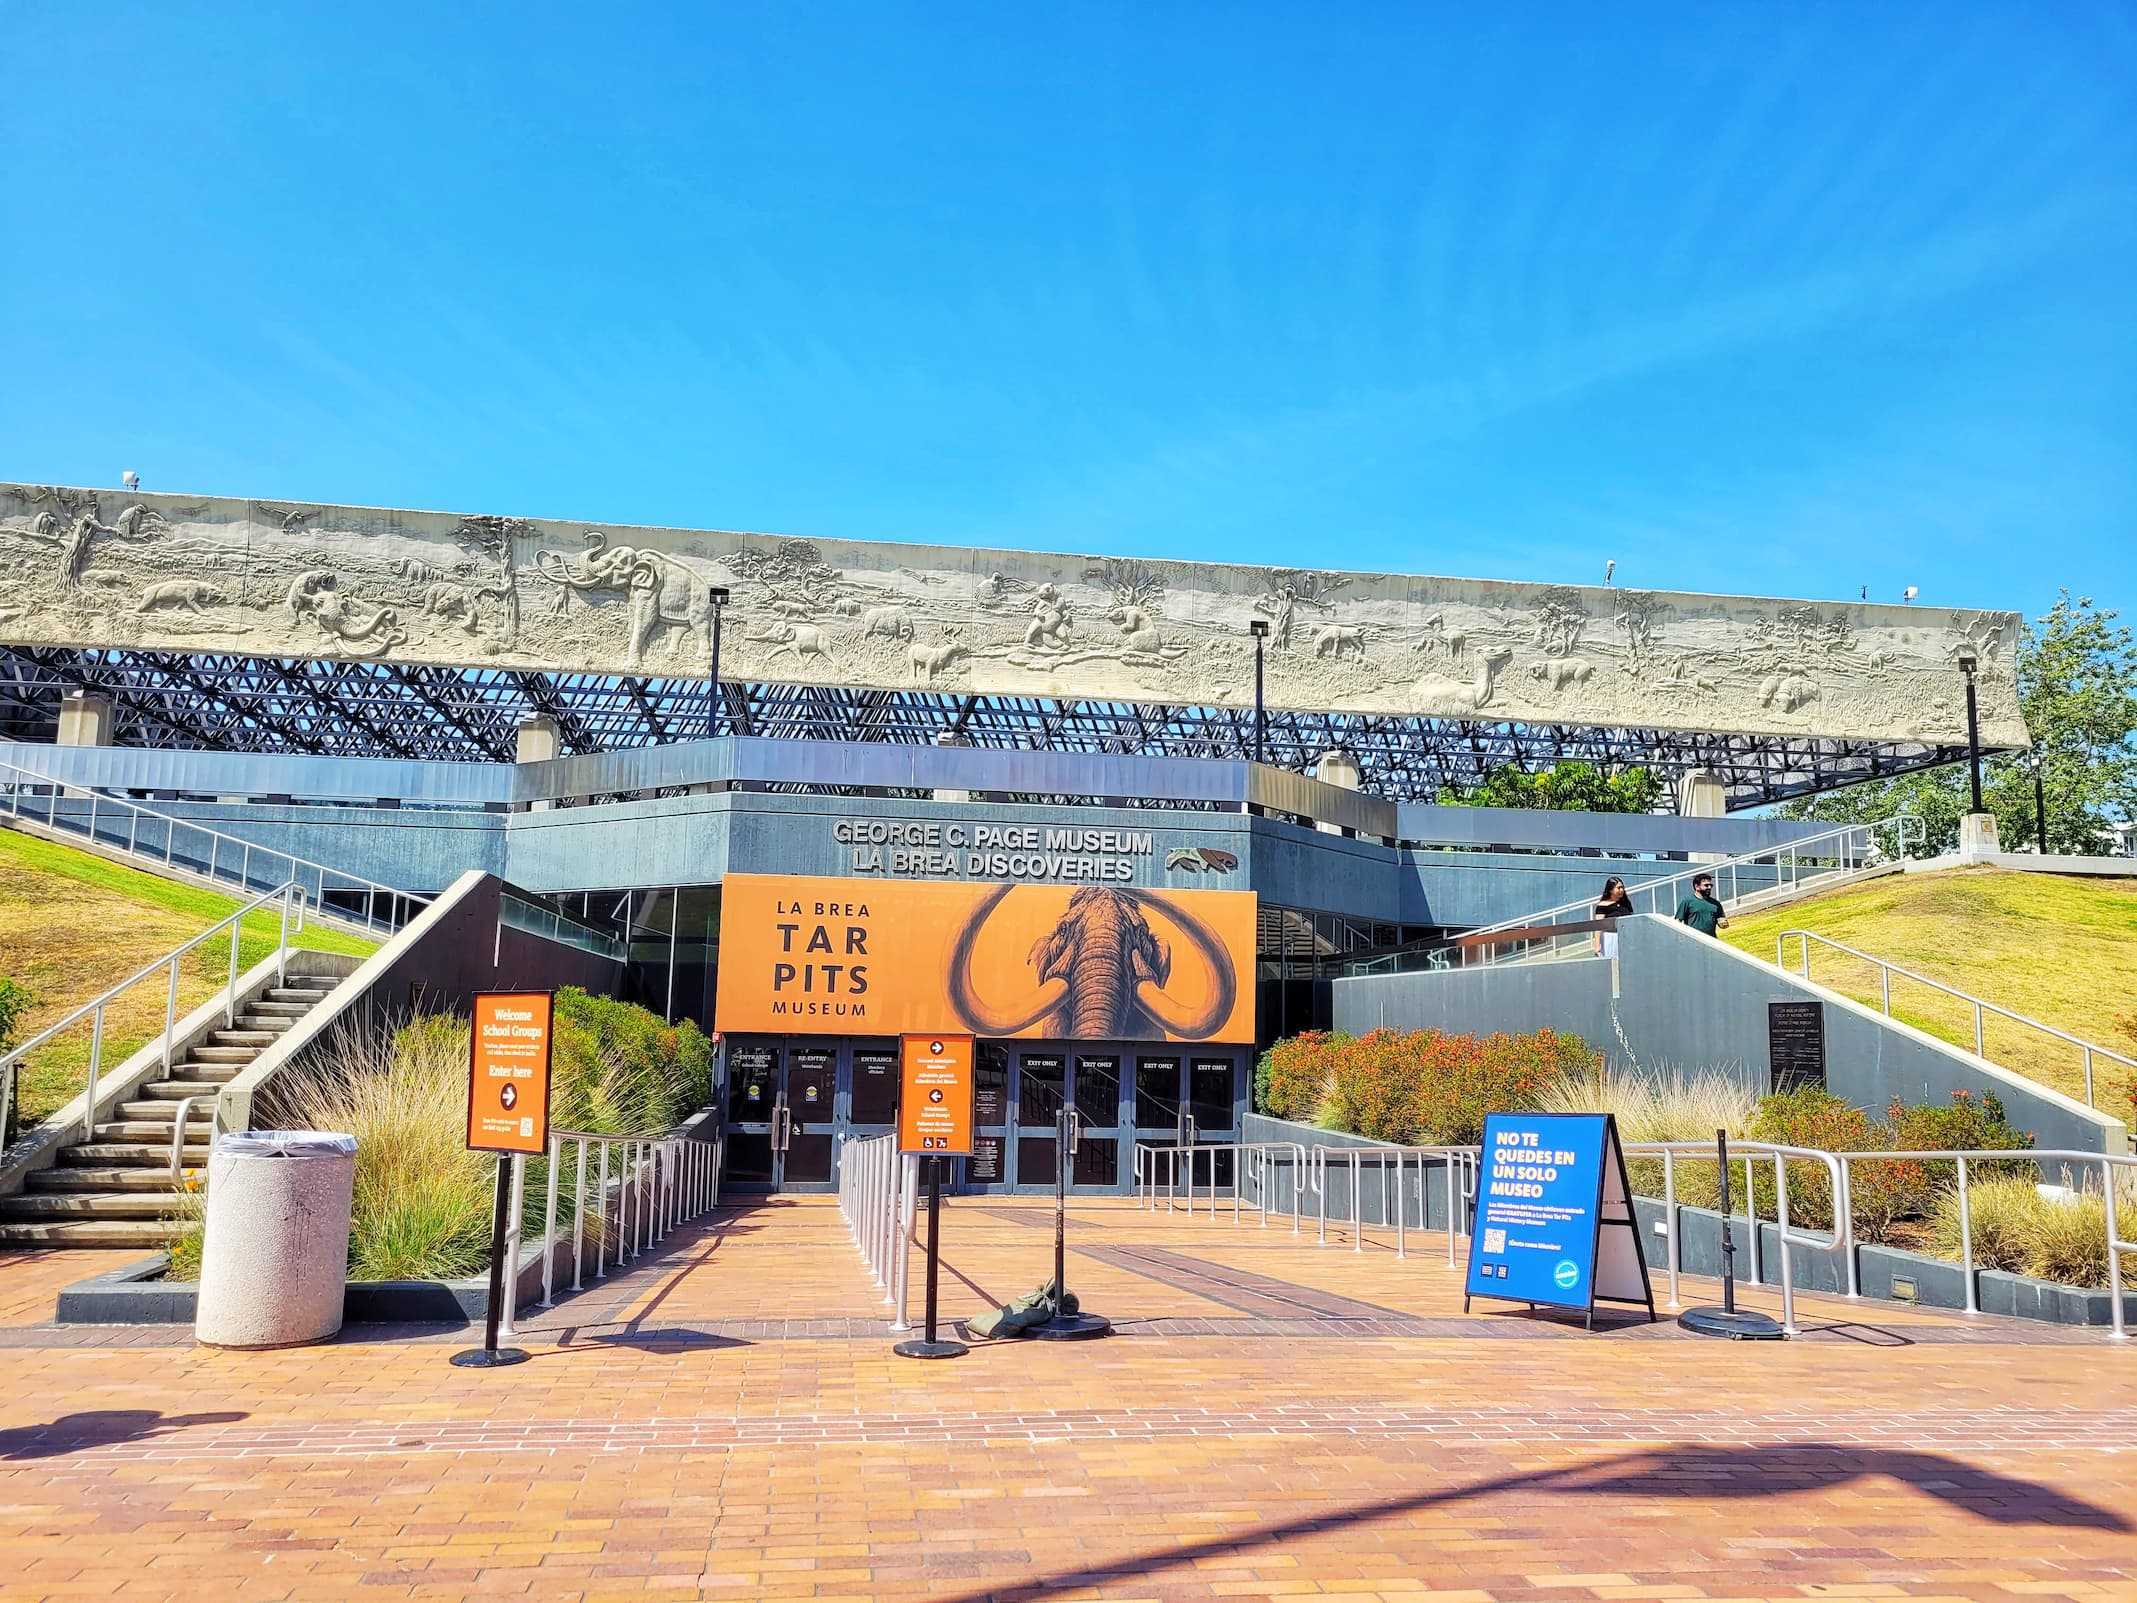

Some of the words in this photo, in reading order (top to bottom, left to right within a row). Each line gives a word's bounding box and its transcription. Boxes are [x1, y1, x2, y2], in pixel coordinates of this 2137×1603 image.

[833, 820, 940, 846] GEORGE
[946, 824, 969, 848] C.
[974, 825, 1038, 849] PAGE
[1045, 829, 1152, 854] MUSEUM
[853, 848, 885, 871] LA
[892, 850, 960, 875] BREA
[967, 852, 1132, 881] DISCOVERIES
[777, 900, 802, 914] LA
[814, 902, 870, 917] BREA
[777, 924, 868, 955] TAR
[774, 963, 868, 994] PITS
[494, 1008, 533, 1021] Welcome
[772, 1001, 866, 1016] MUSEUM
[482, 1024, 510, 1037] School
[511, 1026, 542, 1040] Groups
[488, 1065, 512, 1078] Enter
[513, 1065, 533, 1078] here
[1496, 1132, 1520, 1146] NO
[1521, 1132, 1539, 1147] TE
[1494, 1149, 1552, 1165] QUEDES
[1554, 1151, 1575, 1166] EN
[1493, 1165, 1516, 1179] UN
[1516, 1166, 1557, 1182] SOLO
[1490, 1182, 1543, 1198] MUSEO
